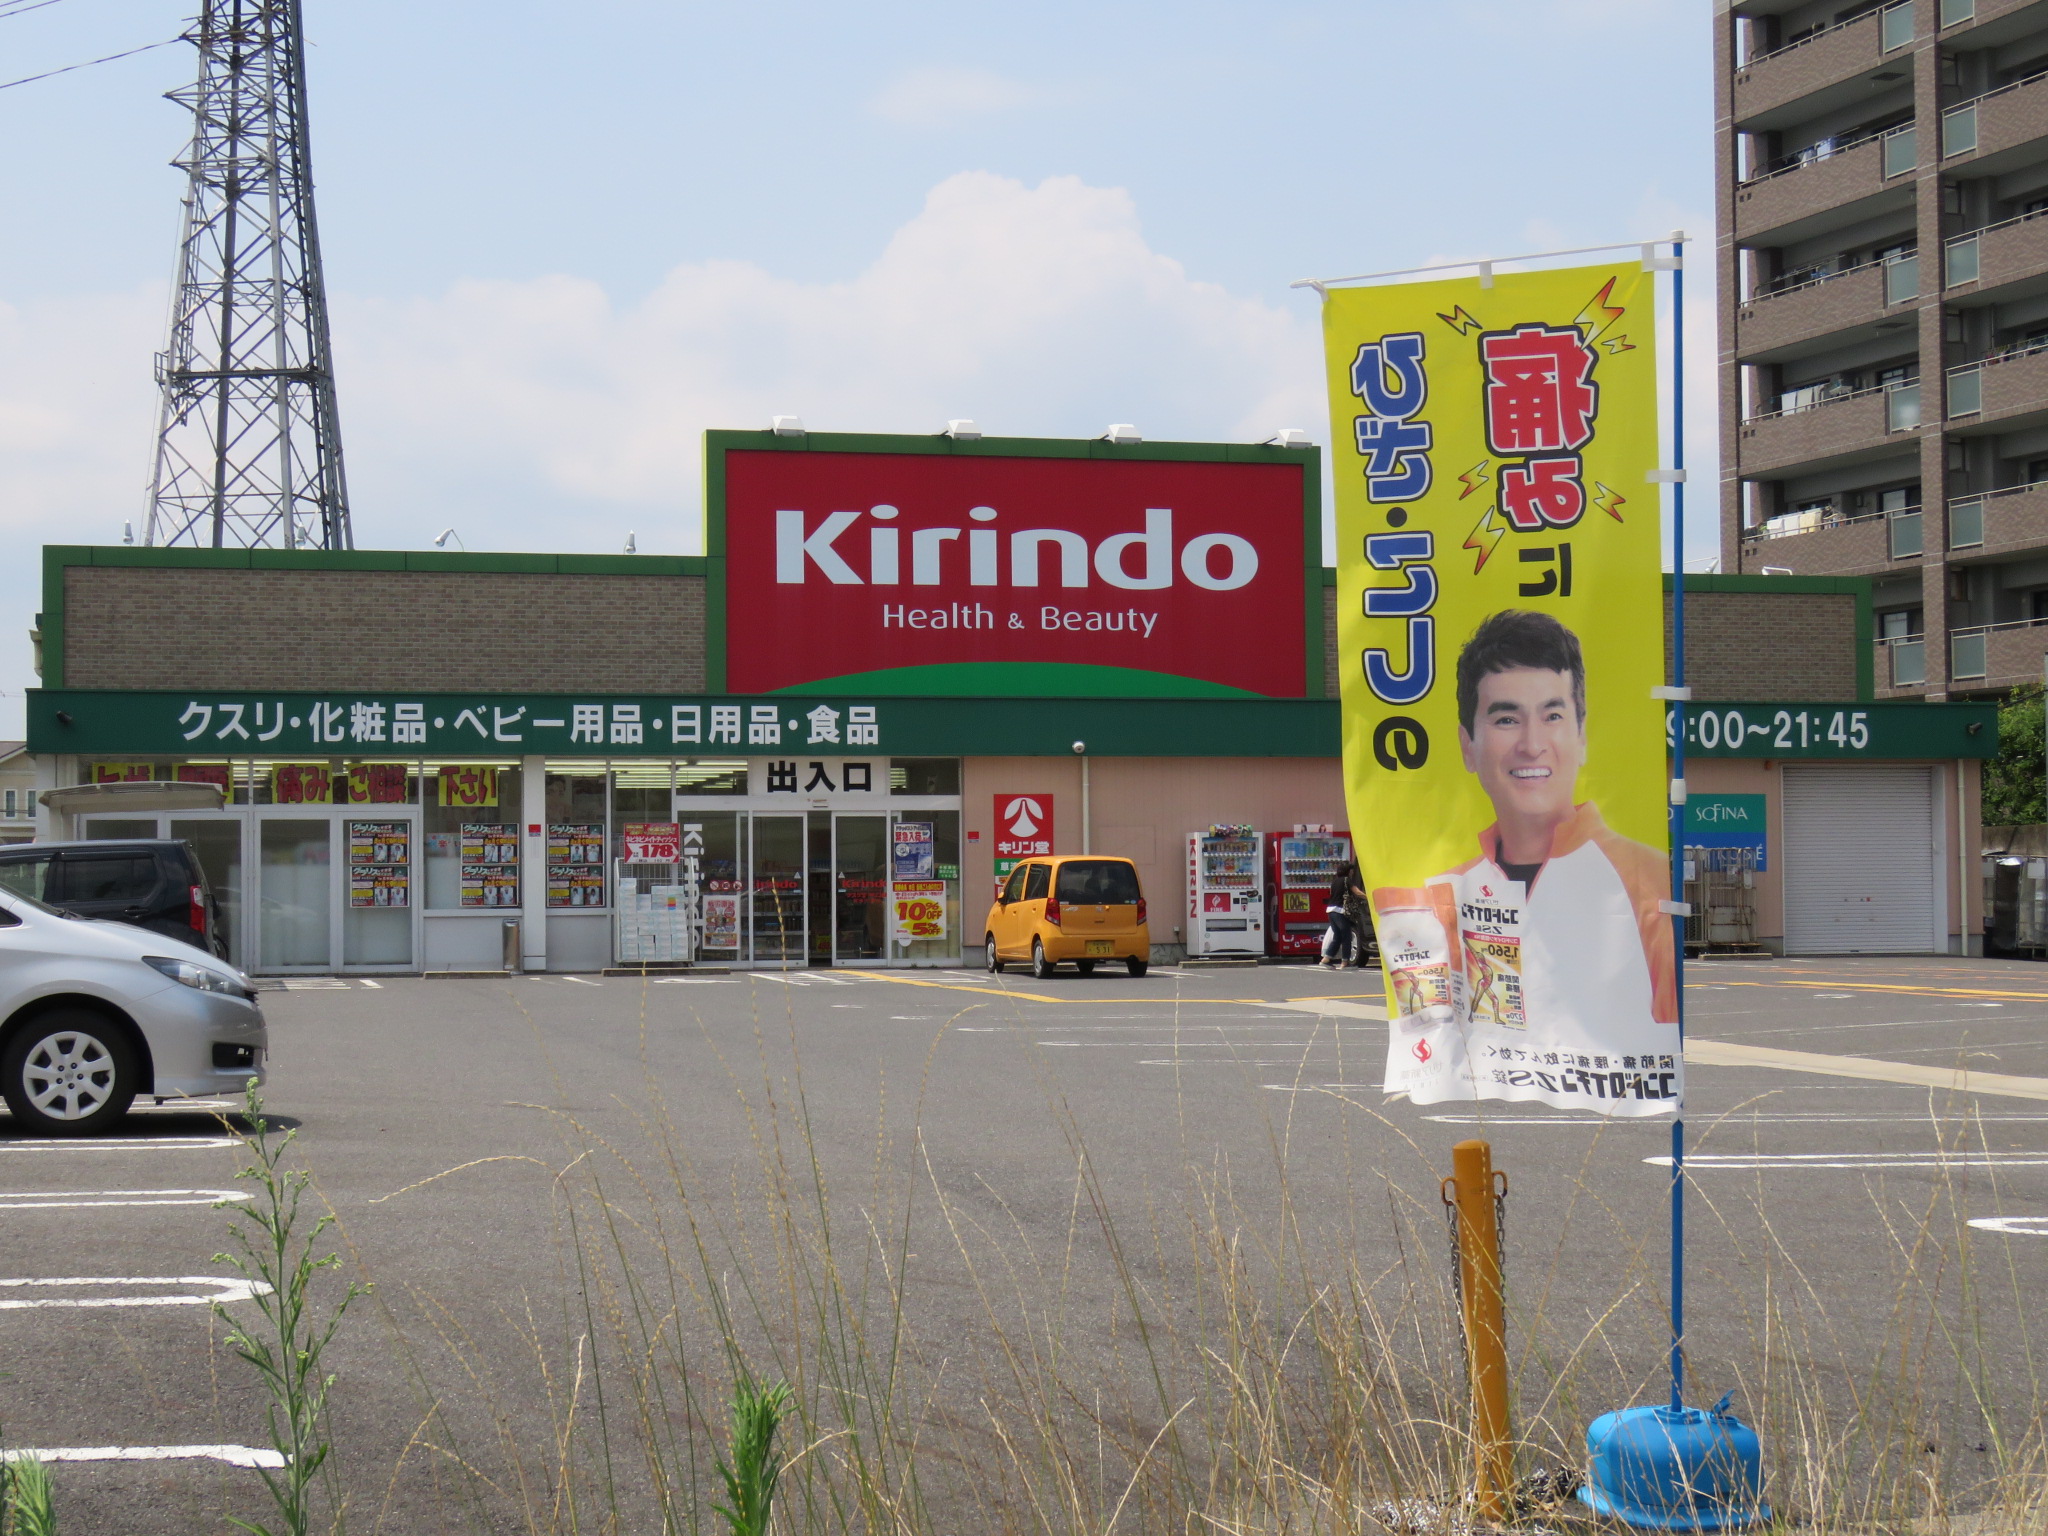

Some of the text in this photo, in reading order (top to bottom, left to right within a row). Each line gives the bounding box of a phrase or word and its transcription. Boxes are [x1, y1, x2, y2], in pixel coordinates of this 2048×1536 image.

[776, 504, 1259, 591] Kirindo
[883, 603, 1158, 638] Health & Beauty
[178, 701, 879, 745] クスリ・化粧品・ベビー用品・日用品・食品
[349, 764, 406, 803] ご相談
[439, 765, 496, 805] 下さい
[767, 760, 871, 793] 出入口
[639, 844, 673, 858] 178
[998, 841, 1050, 855] キリン堂
[1189, 838, 1197, 919] KIRIN
